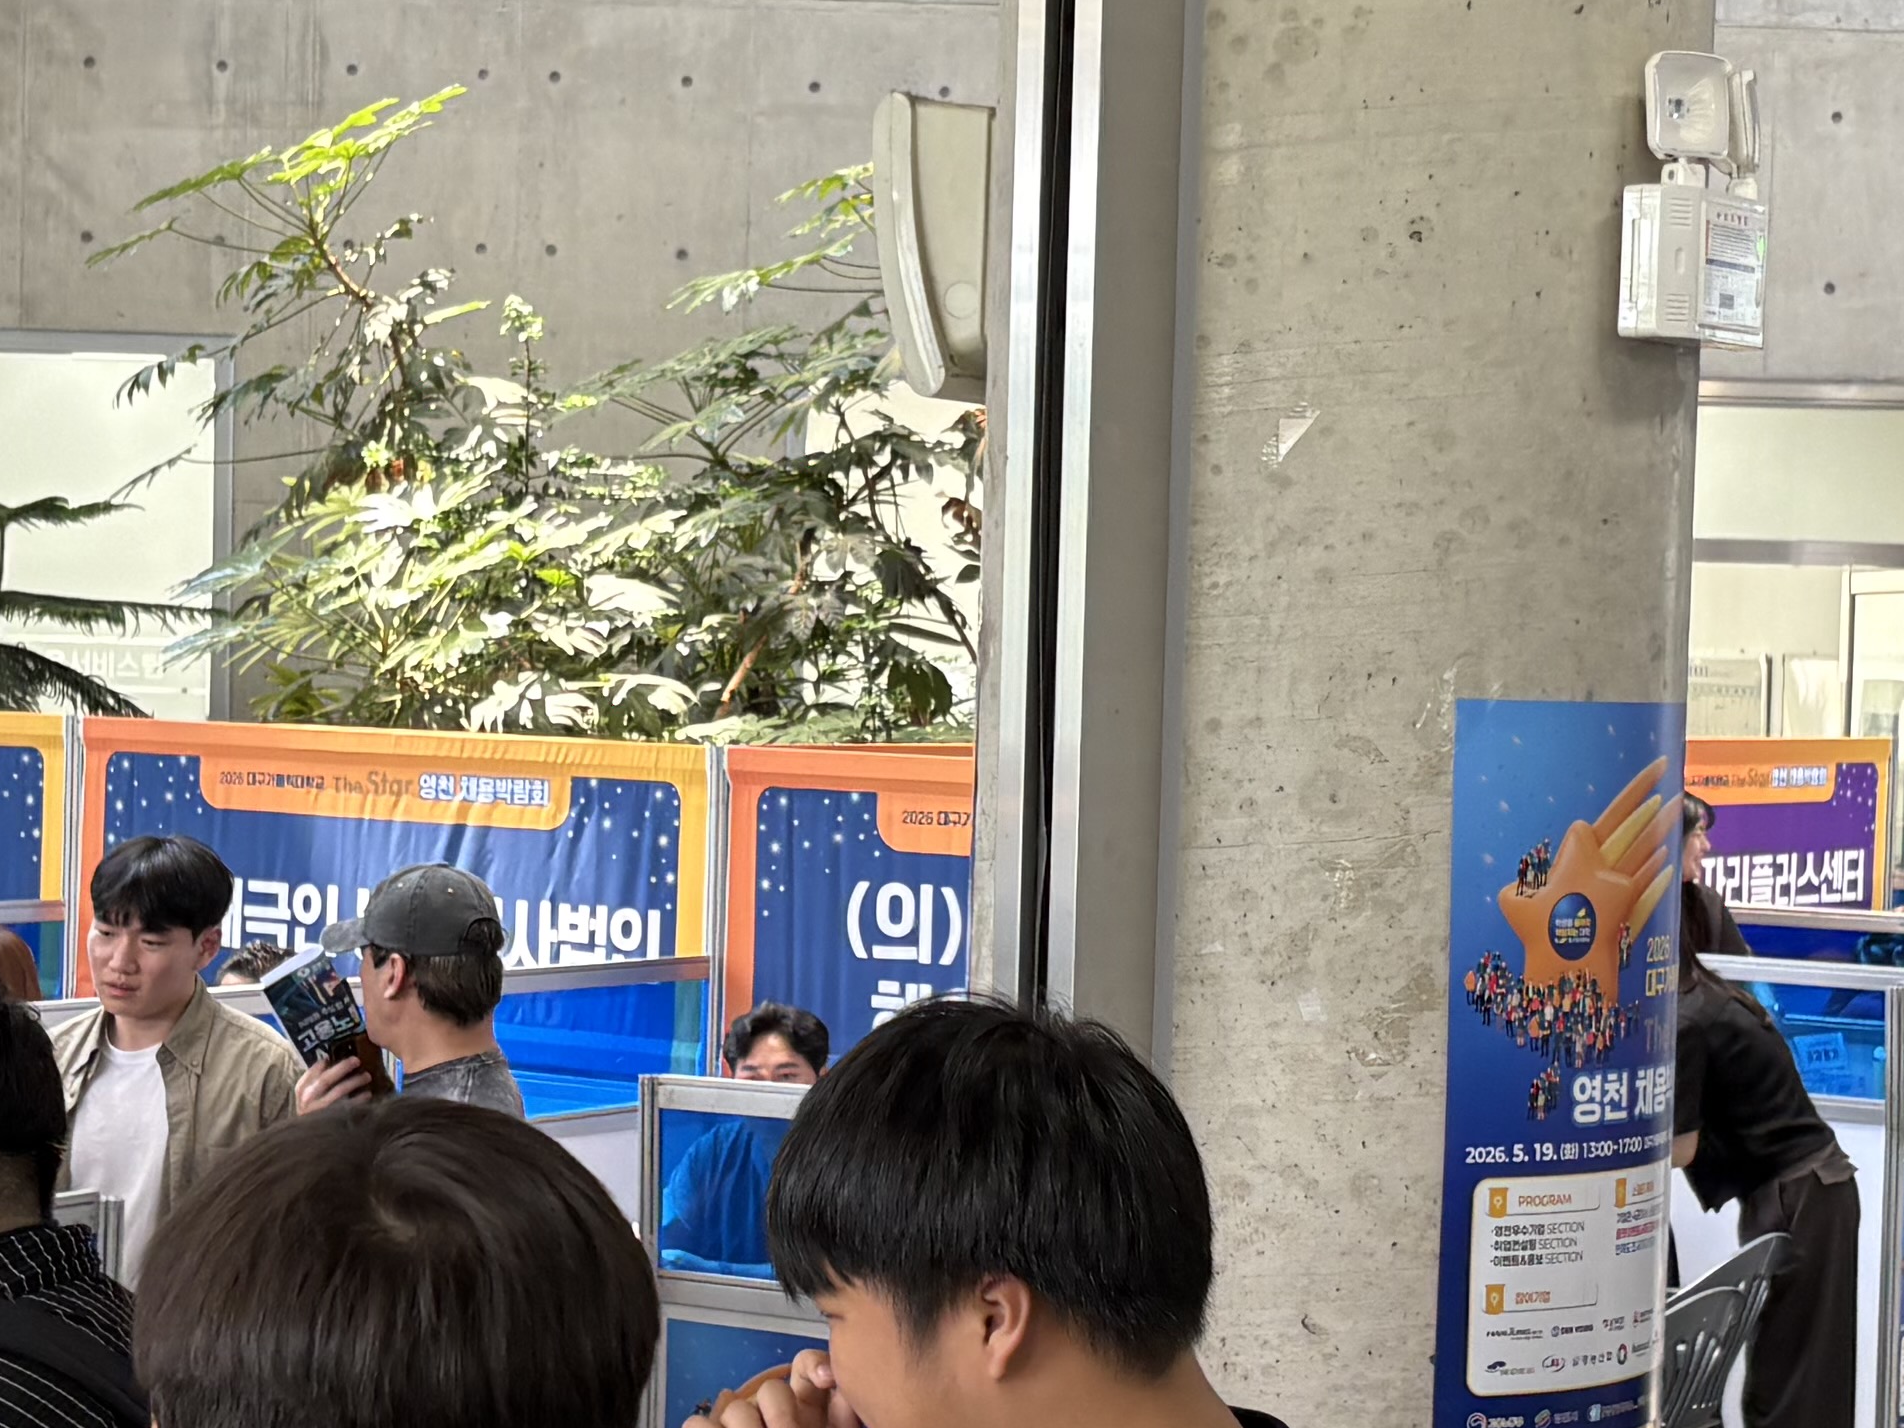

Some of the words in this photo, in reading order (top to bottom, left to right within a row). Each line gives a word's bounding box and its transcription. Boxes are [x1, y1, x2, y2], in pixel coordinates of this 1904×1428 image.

[418, 773, 456, 801] 영천
[459, 775, 551, 807] 채용박람회
[846, 879, 964, 966] (의)
[1572, 1070, 1630, 1125] 영천
[1465, 1146, 1509, 1164] 2026.
[1512, 1142, 1529, 1163] 5.
[1534, 1142, 1557, 1162] 19.
[1518, 1193, 1572, 1208] PROGRAM
[1546, 1221, 1585, 1236] SECTION
[1538, 1236, 1577, 1251] SECTION
[1544, 1251, 1583, 1266] SECTION
